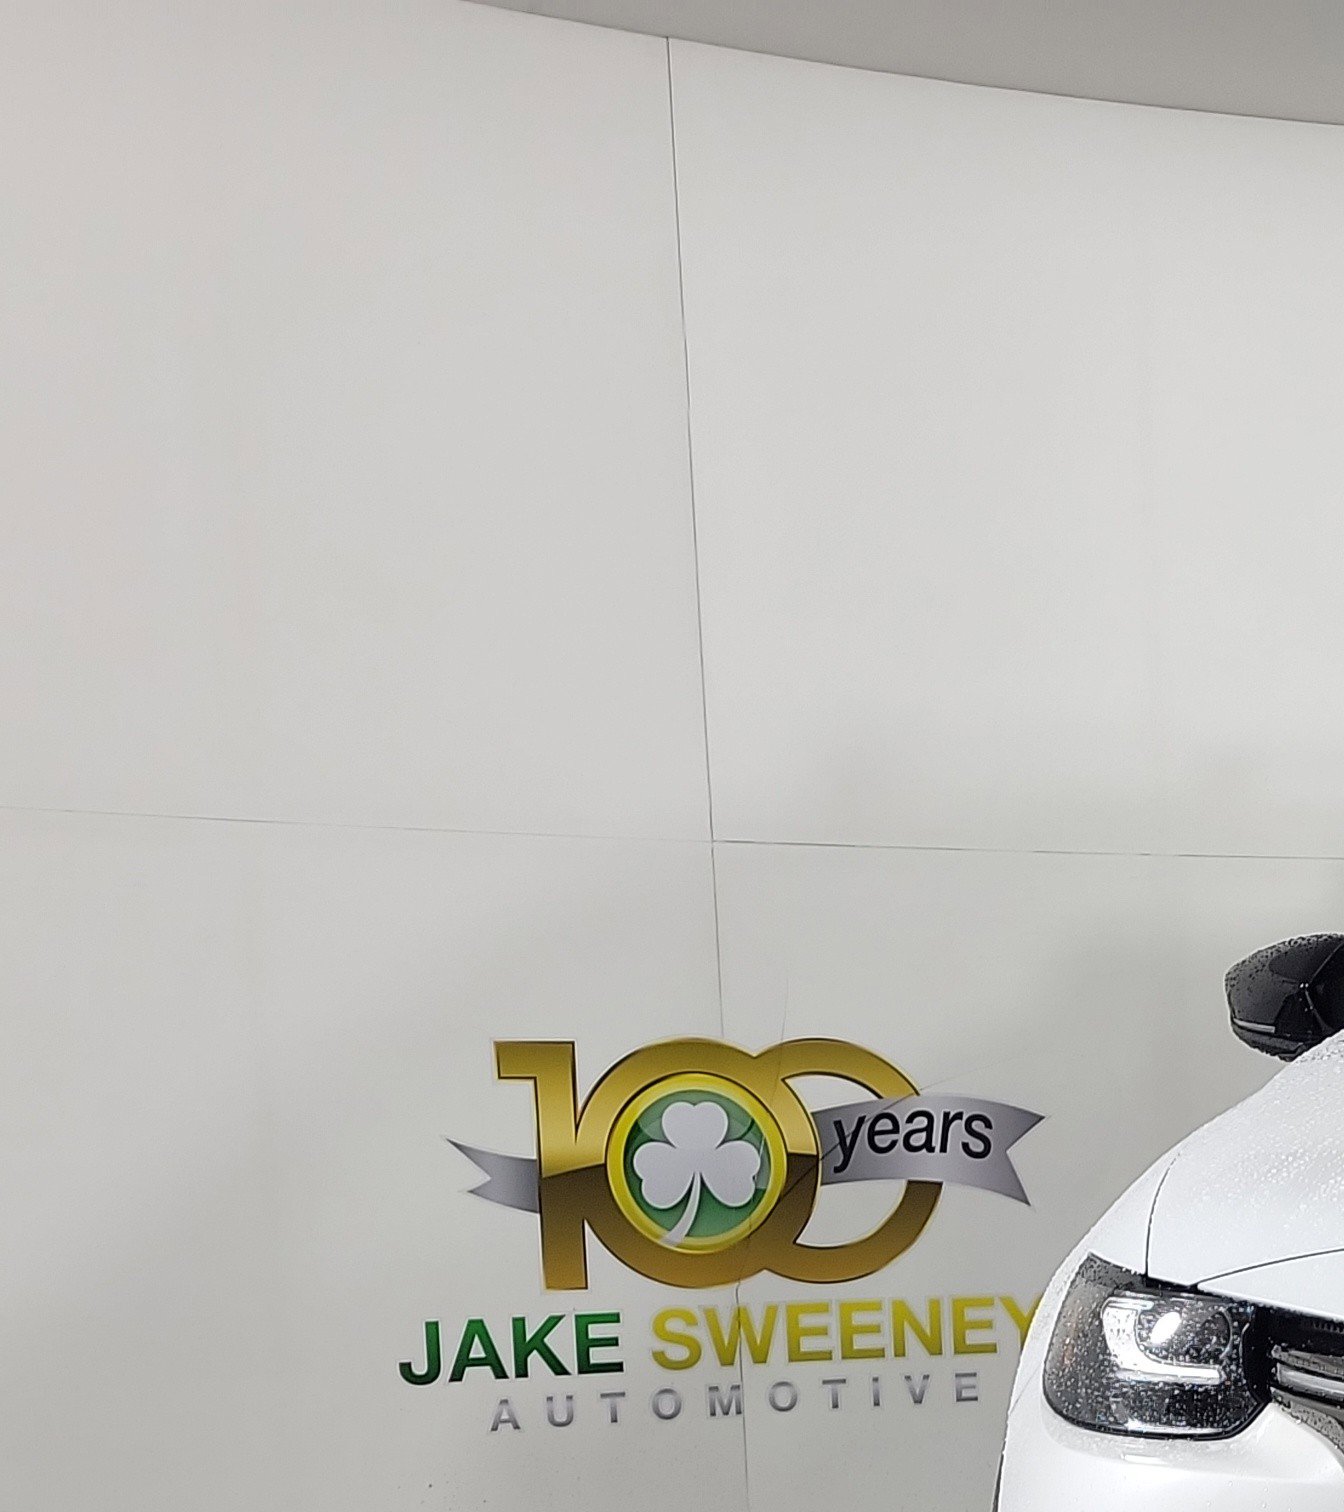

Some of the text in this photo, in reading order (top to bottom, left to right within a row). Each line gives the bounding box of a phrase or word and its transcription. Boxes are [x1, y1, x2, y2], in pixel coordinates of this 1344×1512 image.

[493, 1037, 993, 1291] 100 years
[398, 1311, 625, 1386] JAKE
[490, 1372, 979, 1433] AUTOMOTIVE
